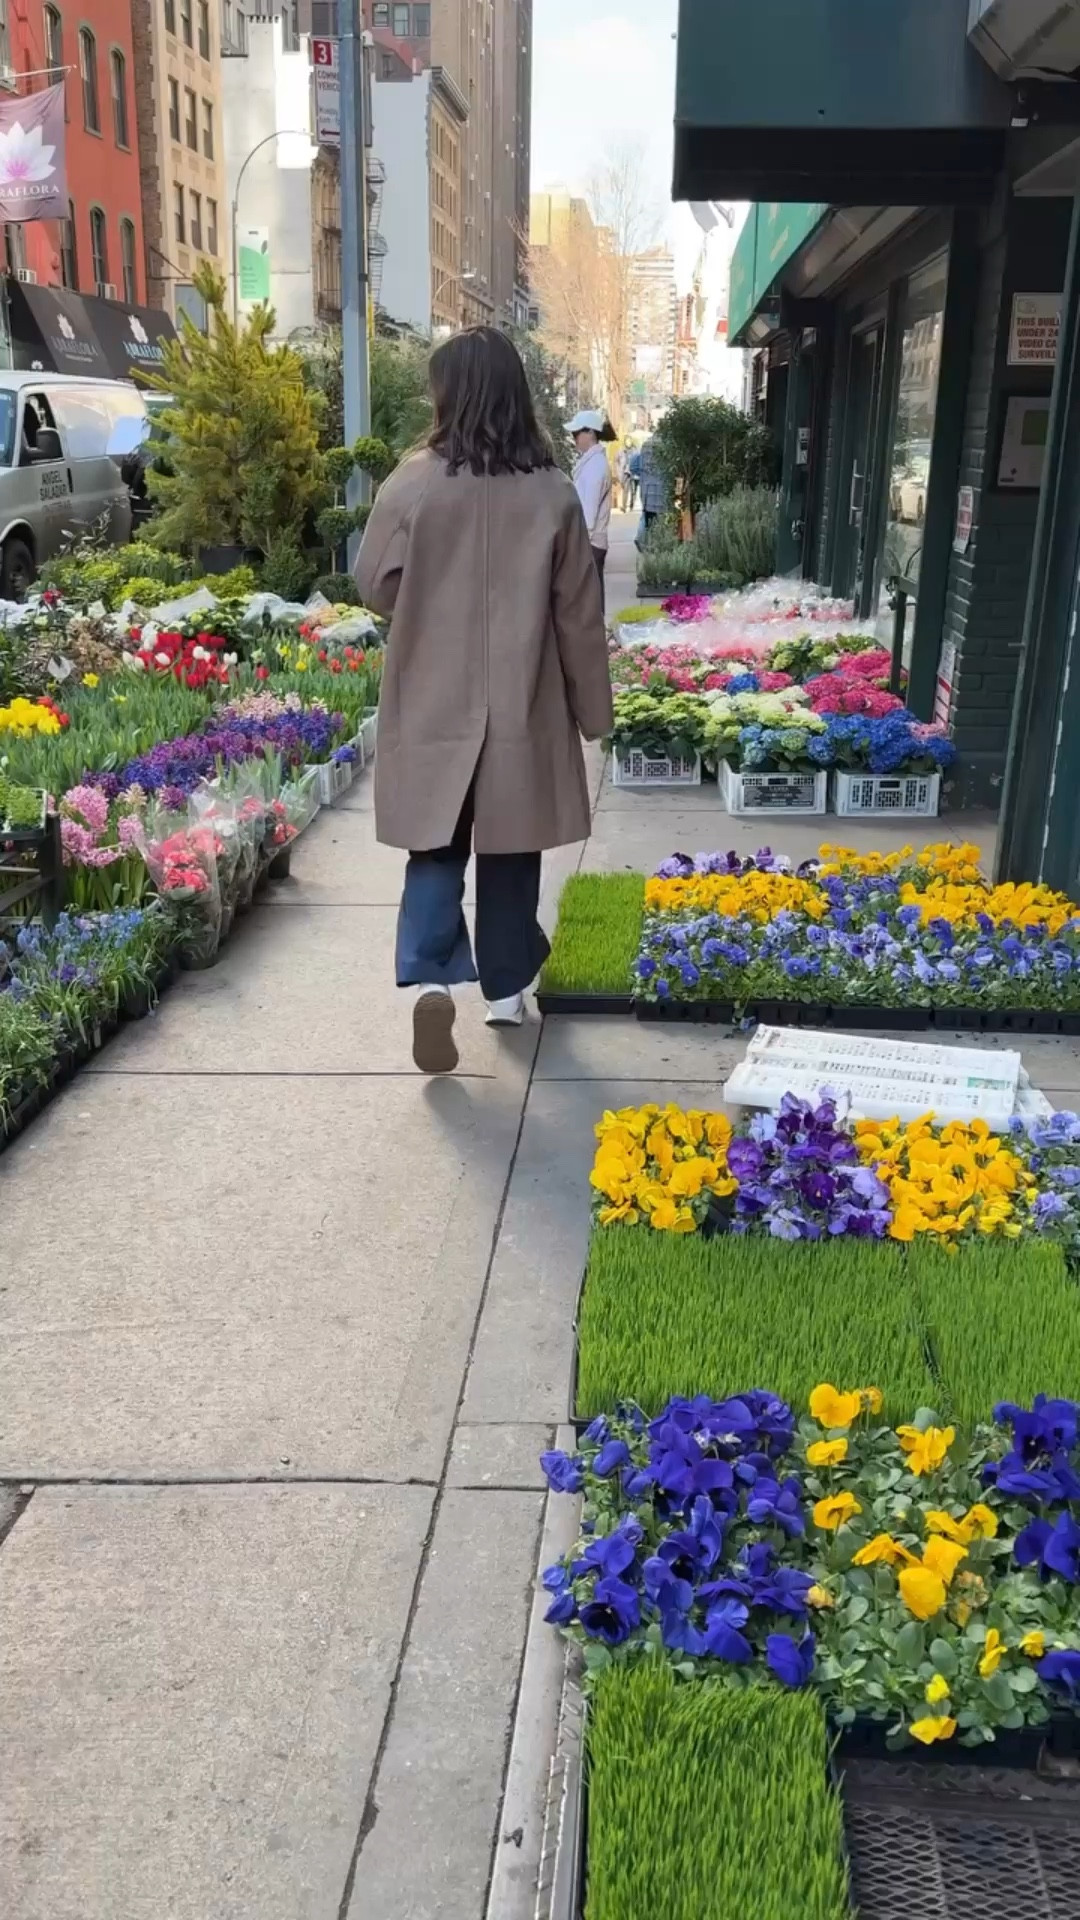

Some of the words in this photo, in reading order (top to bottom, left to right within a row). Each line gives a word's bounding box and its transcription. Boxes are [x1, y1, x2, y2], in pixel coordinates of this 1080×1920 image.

[317, 43, 328, 63] 3
[1016, 317, 1036, 326] THIS
[1016, 328, 1045, 337] UNDER
[1018, 339, 1043, 348] VIDEO
